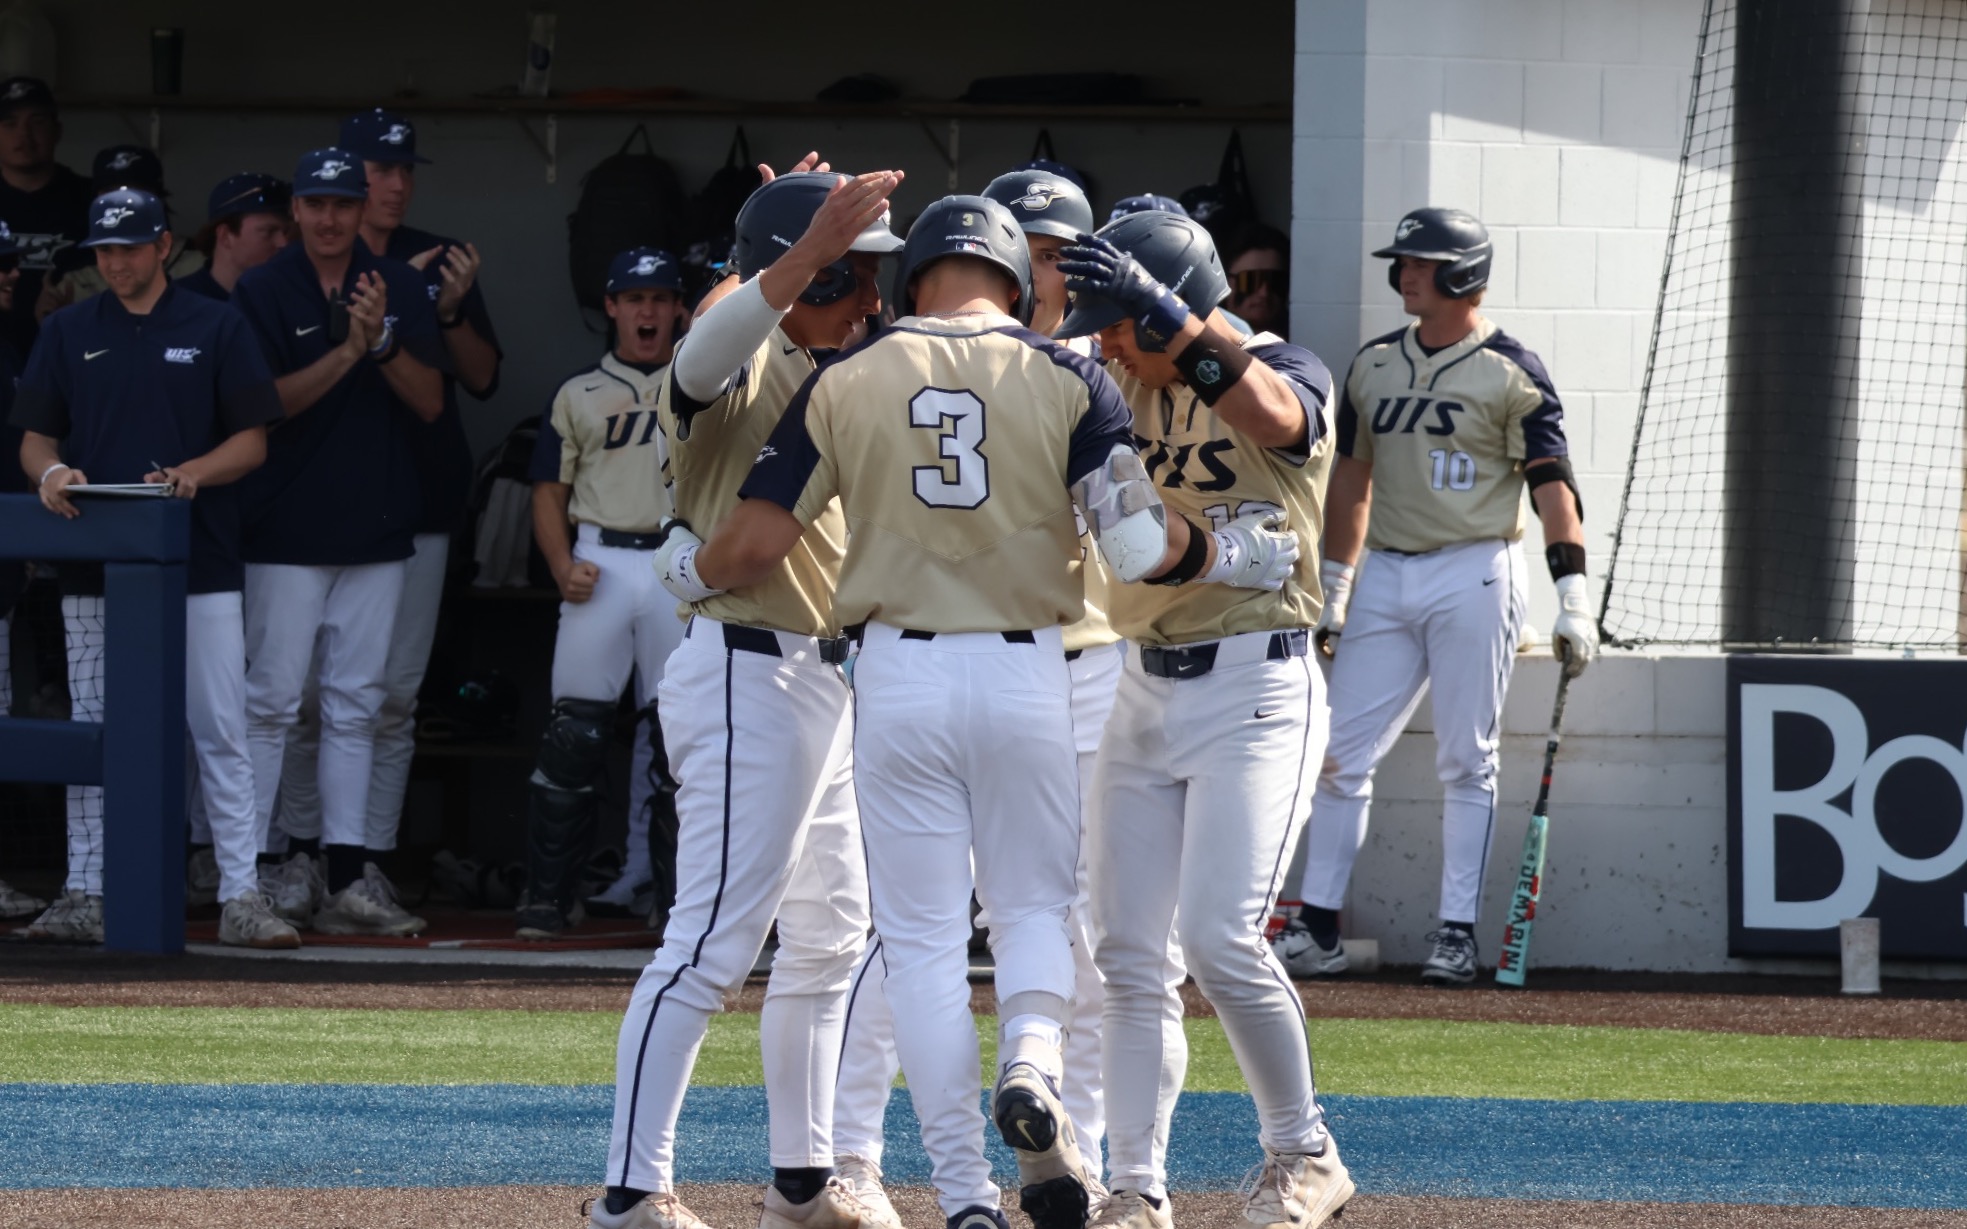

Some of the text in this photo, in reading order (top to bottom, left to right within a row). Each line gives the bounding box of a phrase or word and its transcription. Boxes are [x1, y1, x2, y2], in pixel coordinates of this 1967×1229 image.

[962, 213, 974, 227] 3
[603, 411, 658, 450] UI
[1371, 397, 1464, 436] UIS
[908, 385, 990, 510] 3
[1428, 448, 1477, 492] 10
[1741, 683, 1967, 930] Bo
[1506, 865, 1537, 973] DEMARINI
